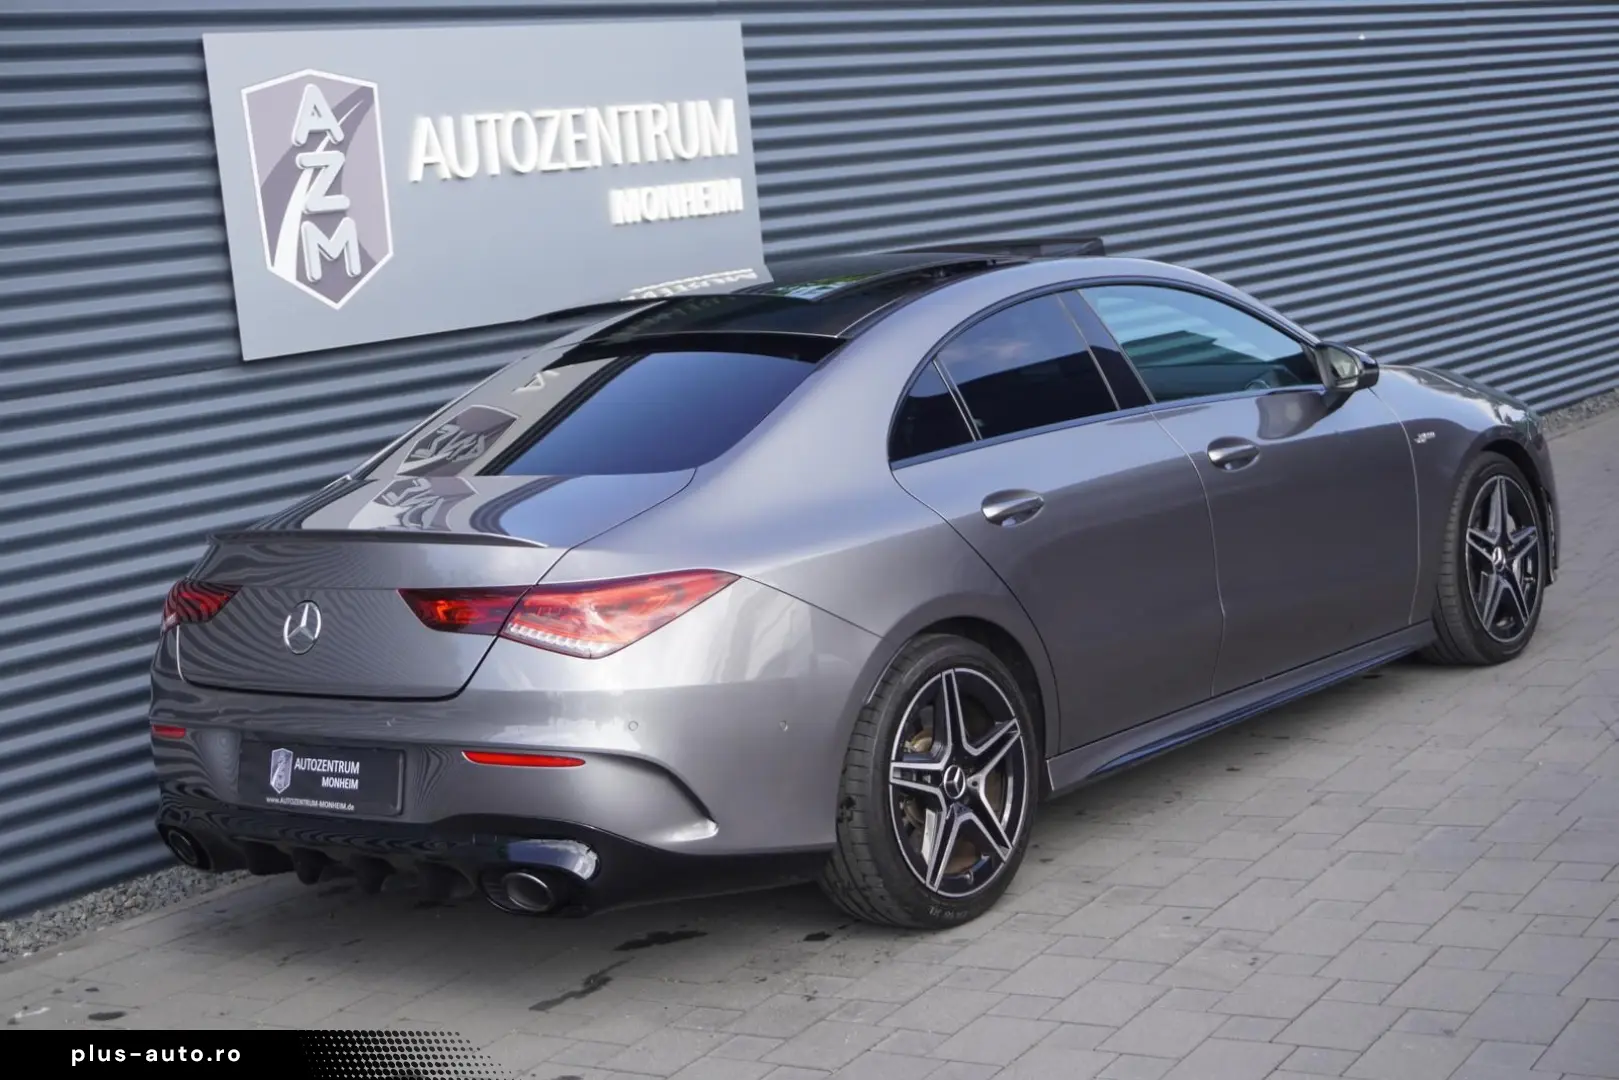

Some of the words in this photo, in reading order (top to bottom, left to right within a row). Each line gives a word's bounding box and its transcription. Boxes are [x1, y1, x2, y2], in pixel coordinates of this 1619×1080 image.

[408, 98, 738, 183] AUTOZENTRUM
[609, 178, 744, 225] MONHEIM
[294, 757, 360, 775] AUTOZENTRUM
[321, 776, 359, 790] MONHEIM
